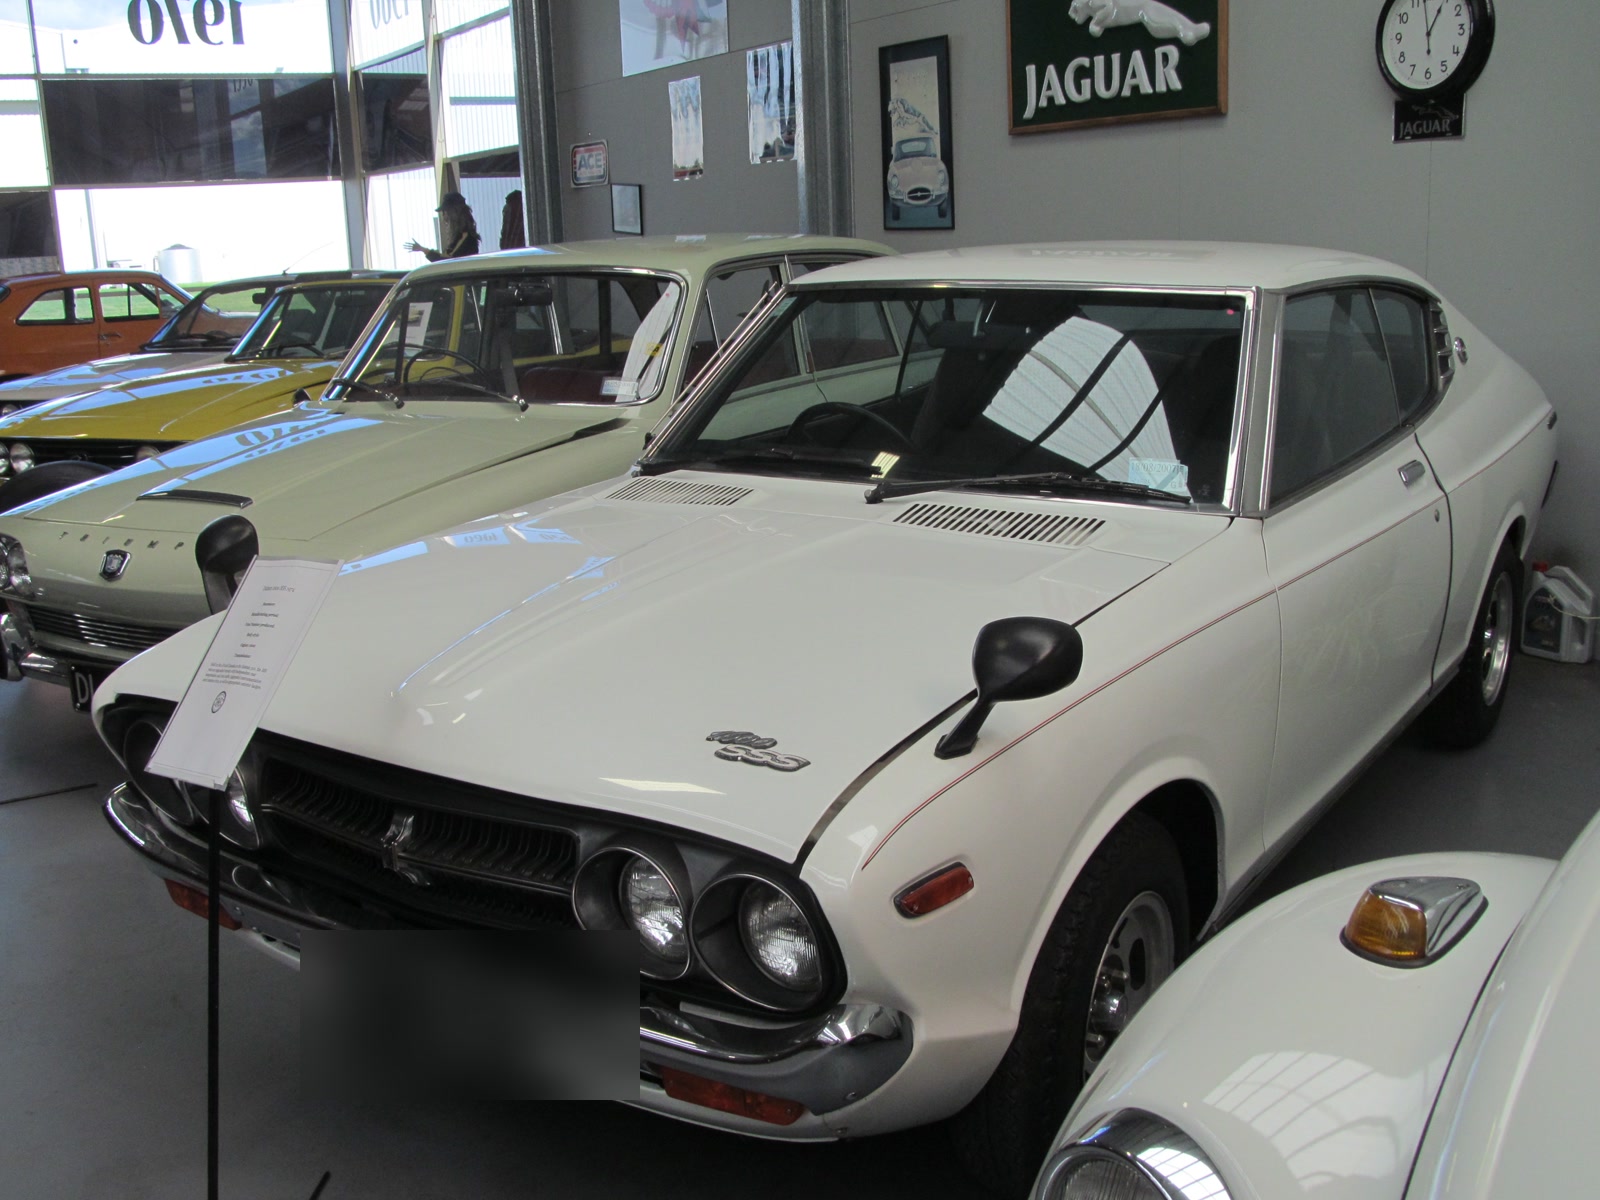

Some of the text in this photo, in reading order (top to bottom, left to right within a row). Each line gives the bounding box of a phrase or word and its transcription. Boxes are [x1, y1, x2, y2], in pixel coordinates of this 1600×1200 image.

[1455, 4, 1462, 17] 2
[1398, 12, 1409, 25] 10
[1458, 23, 1465, 36] 3
[1395, 32, 1403, 44] 9
[1398, 51, 1406, 63] 8
[1453, 45, 1460, 56] 4
[1409, 64, 1416, 76] 7
[1440, 60, 1448, 73] 5
[1424, 67, 1432, 80] 6
[1023, 44, 1183, 120] JAGUAR
[1399, 119, 1451, 139] JAGUAR
[578, 152, 603, 171] ACE
[59, 531, 185, 550] TRIUMP
